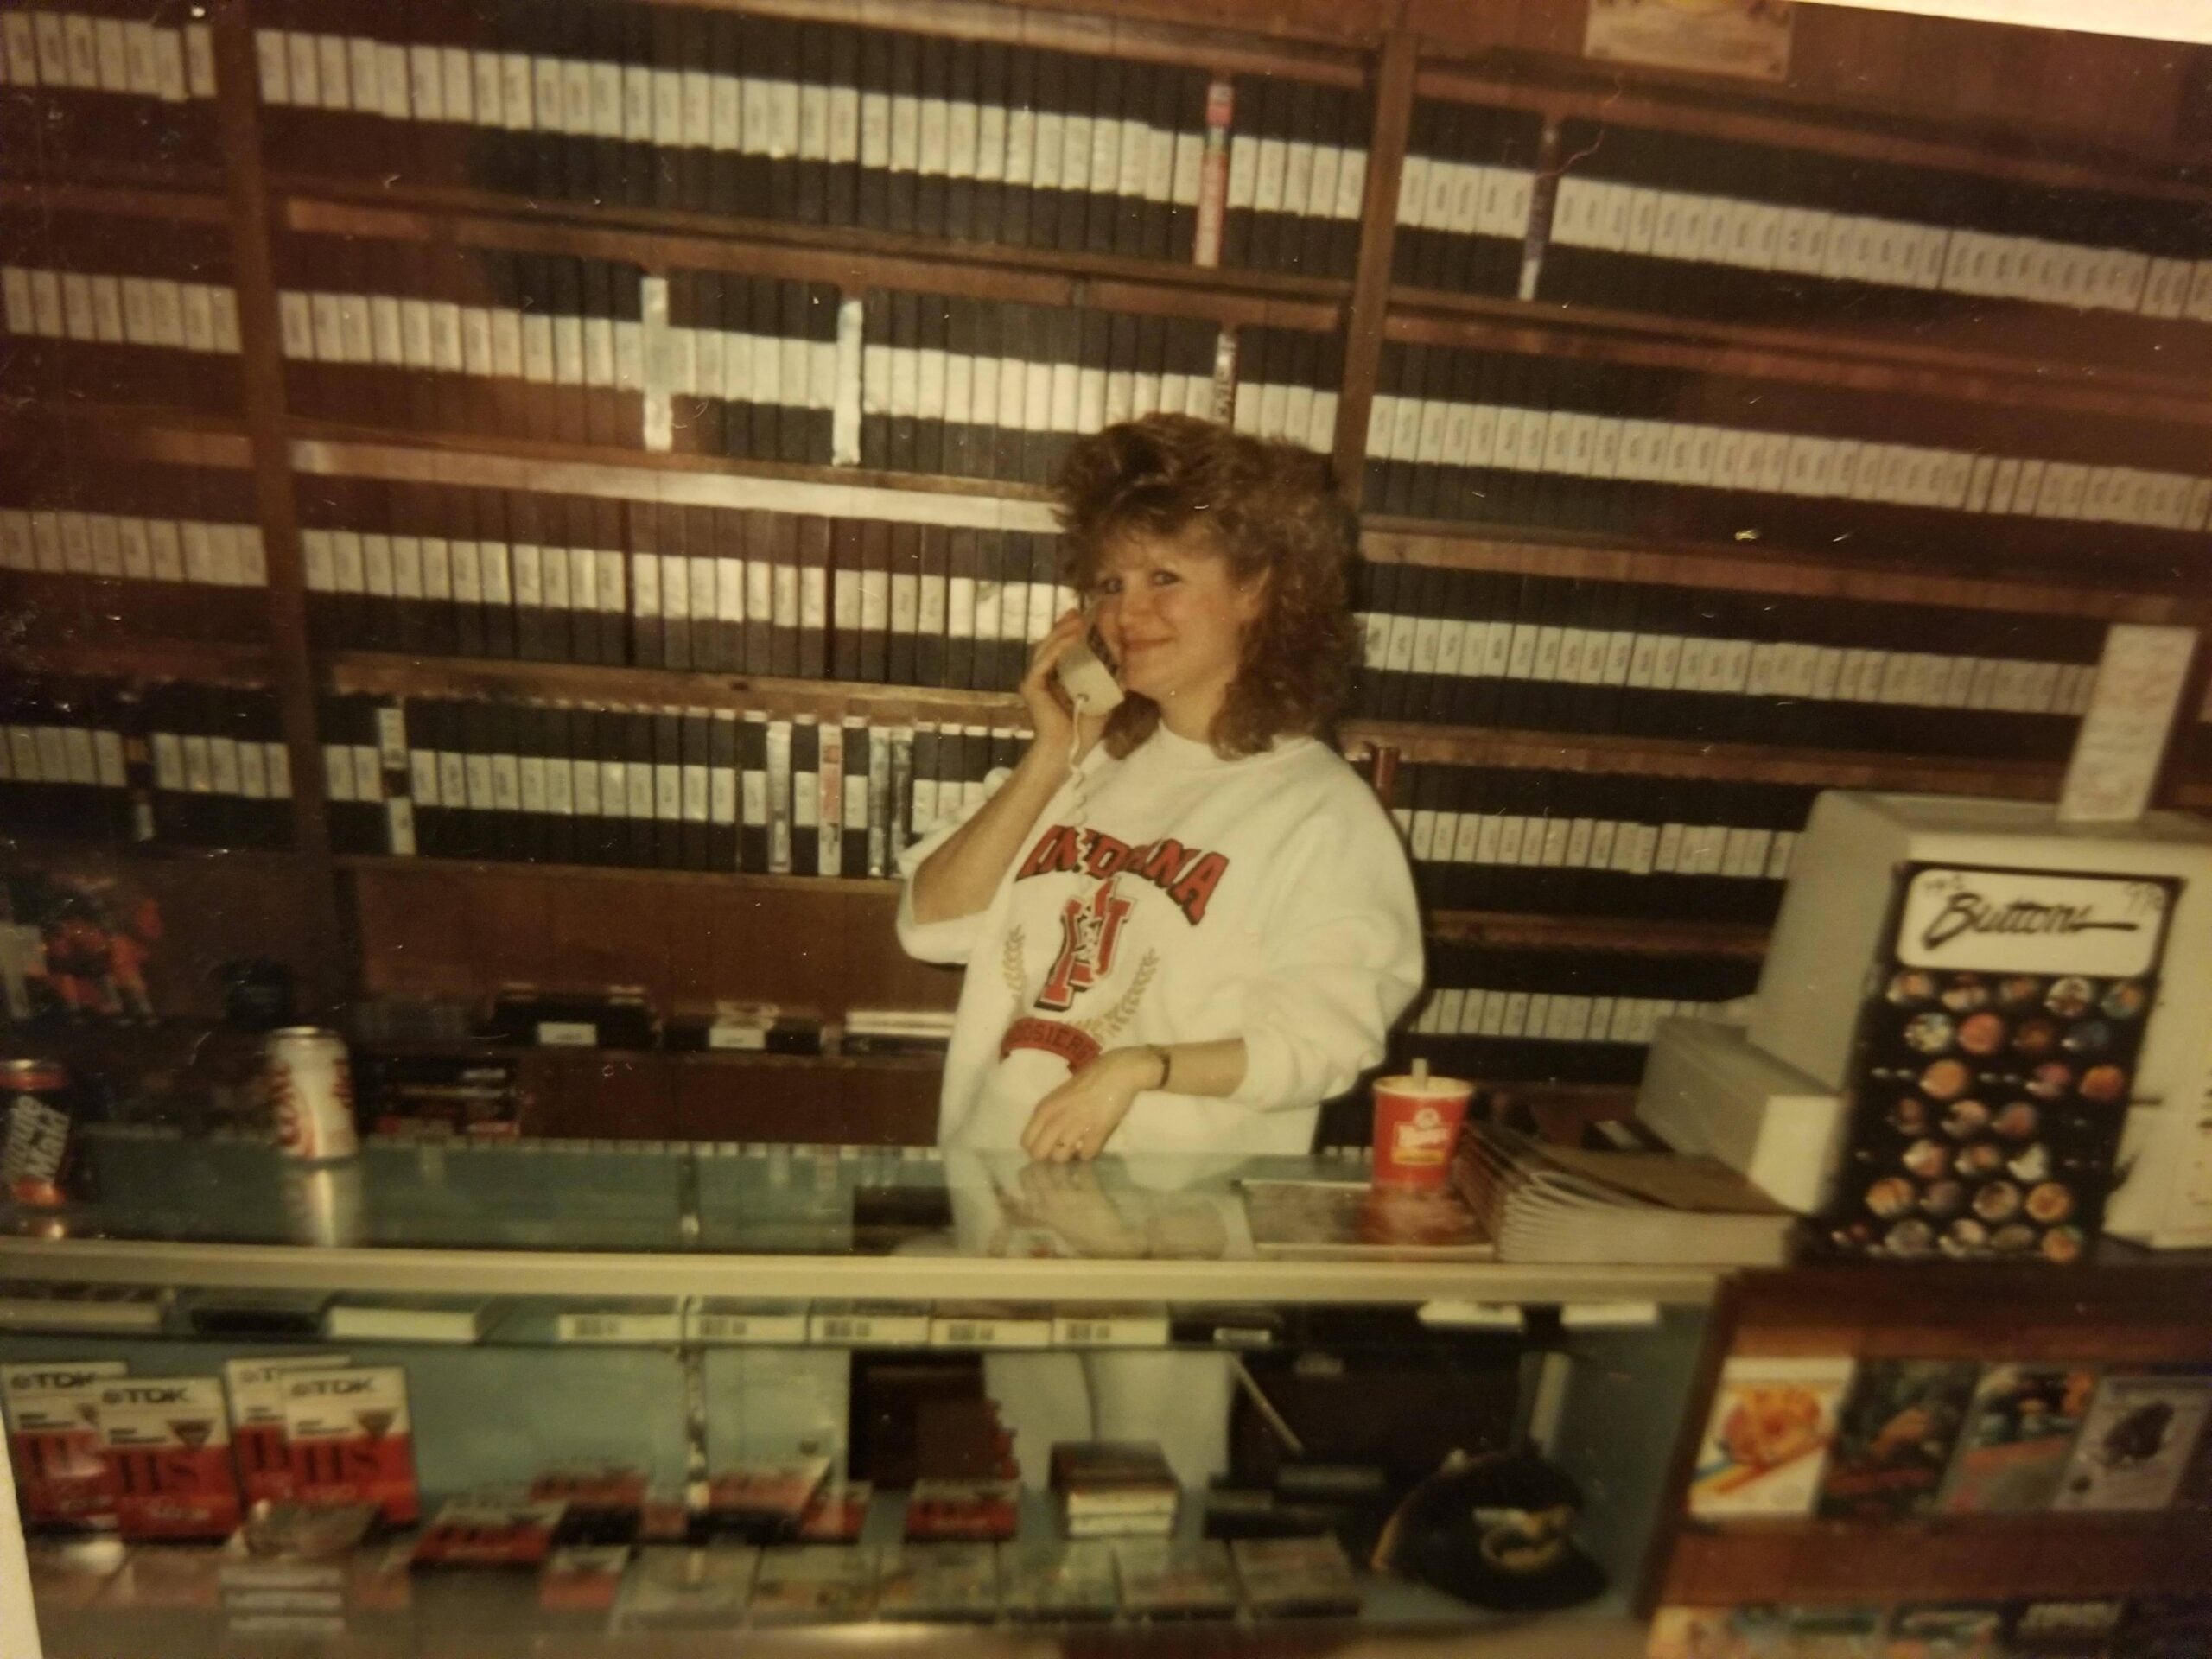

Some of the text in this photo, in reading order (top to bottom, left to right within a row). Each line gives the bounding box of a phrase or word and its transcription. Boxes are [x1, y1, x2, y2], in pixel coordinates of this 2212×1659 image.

[1014, 825, 1230, 926] INDNA
[1921, 892, 2139, 950] Buttons
[126, 1387, 191, 1404] TDK
[315, 1379, 374, 1396] TDK
